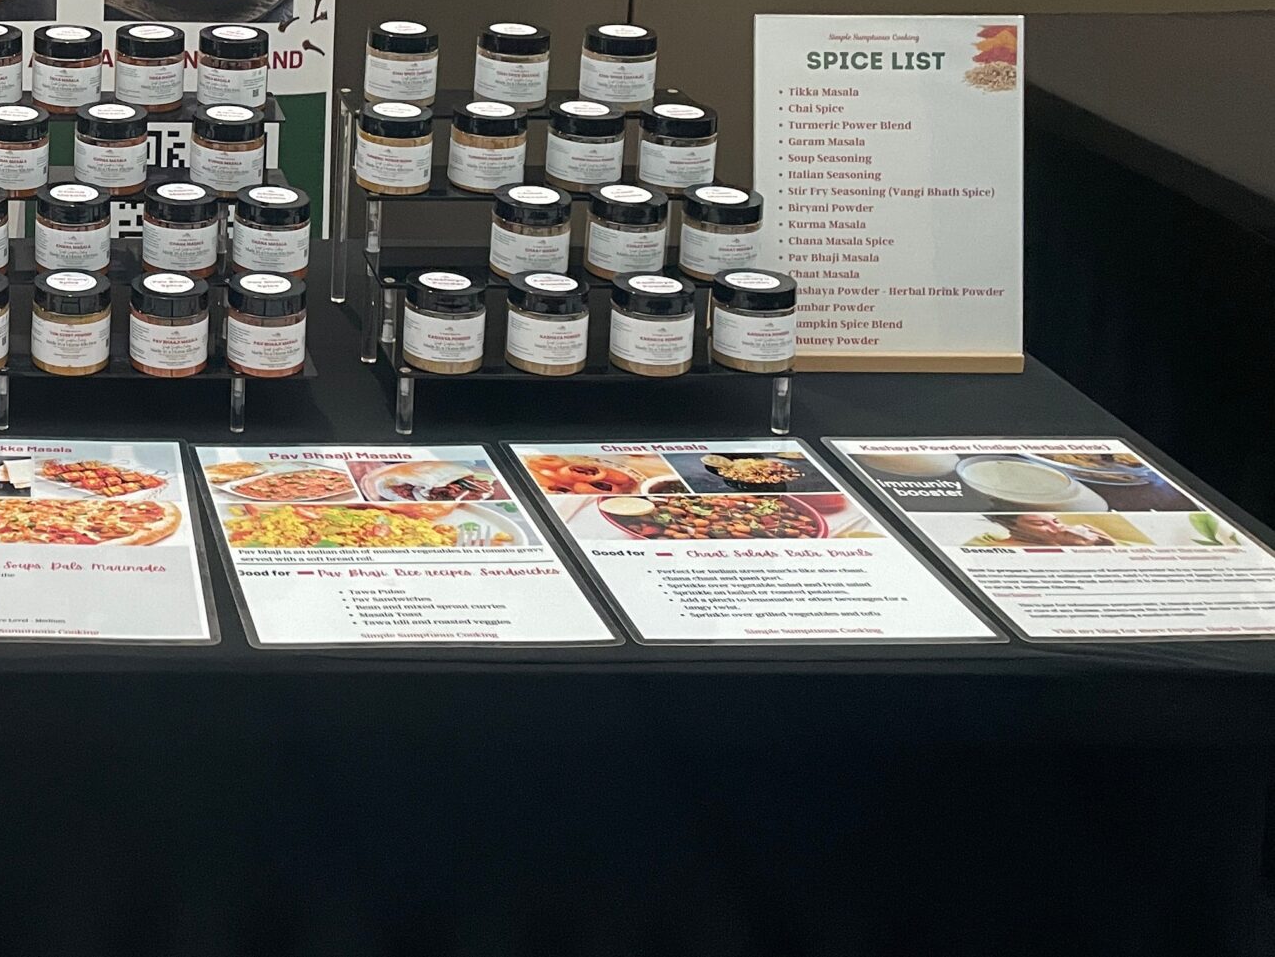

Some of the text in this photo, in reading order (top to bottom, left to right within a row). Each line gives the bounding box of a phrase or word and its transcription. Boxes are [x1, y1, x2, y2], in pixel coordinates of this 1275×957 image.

[807, 52, 945, 70] SPICE LIST
[789, 87, 859, 96] Tikka Masala
[789, 104, 844, 114] Chai Spice
[789, 121, 911, 129] Turmeric Power Blend
[789, 138, 865, 146] Garam Masala
[788, 154, 872, 164] Soup Seasoning
[789, 170, 881, 181] Italian Seasoning
[788, 186, 994, 198] Stir Fry Seasoning (Vangi Bhath Spice)
[789, 203, 874, 213] Biryani Powder
[789, 220, 866, 228] Kurma Masala
[789, 237, 894, 247] Chana Masala Spice
[811, 253, 839, 264] Bhaji
[842, 254, 879, 262] Masala
[789, 270, 859, 278] Chaat Masala
[796, 287, 835, 297] ashaya
[838, 286, 880, 295] Powder
[889, 287, 925, 295] Herbal
[929, 287, 959, 296] Drink
[963, 288, 1005, 296] Powder
[833, 303, 875, 312] Powder
[796, 319, 902, 330] umpkin Spice Blend
[796, 336, 879, 346] hutney Powder
[879, 479, 961, 490] immunity
[896, 488, 964, 497] booster
